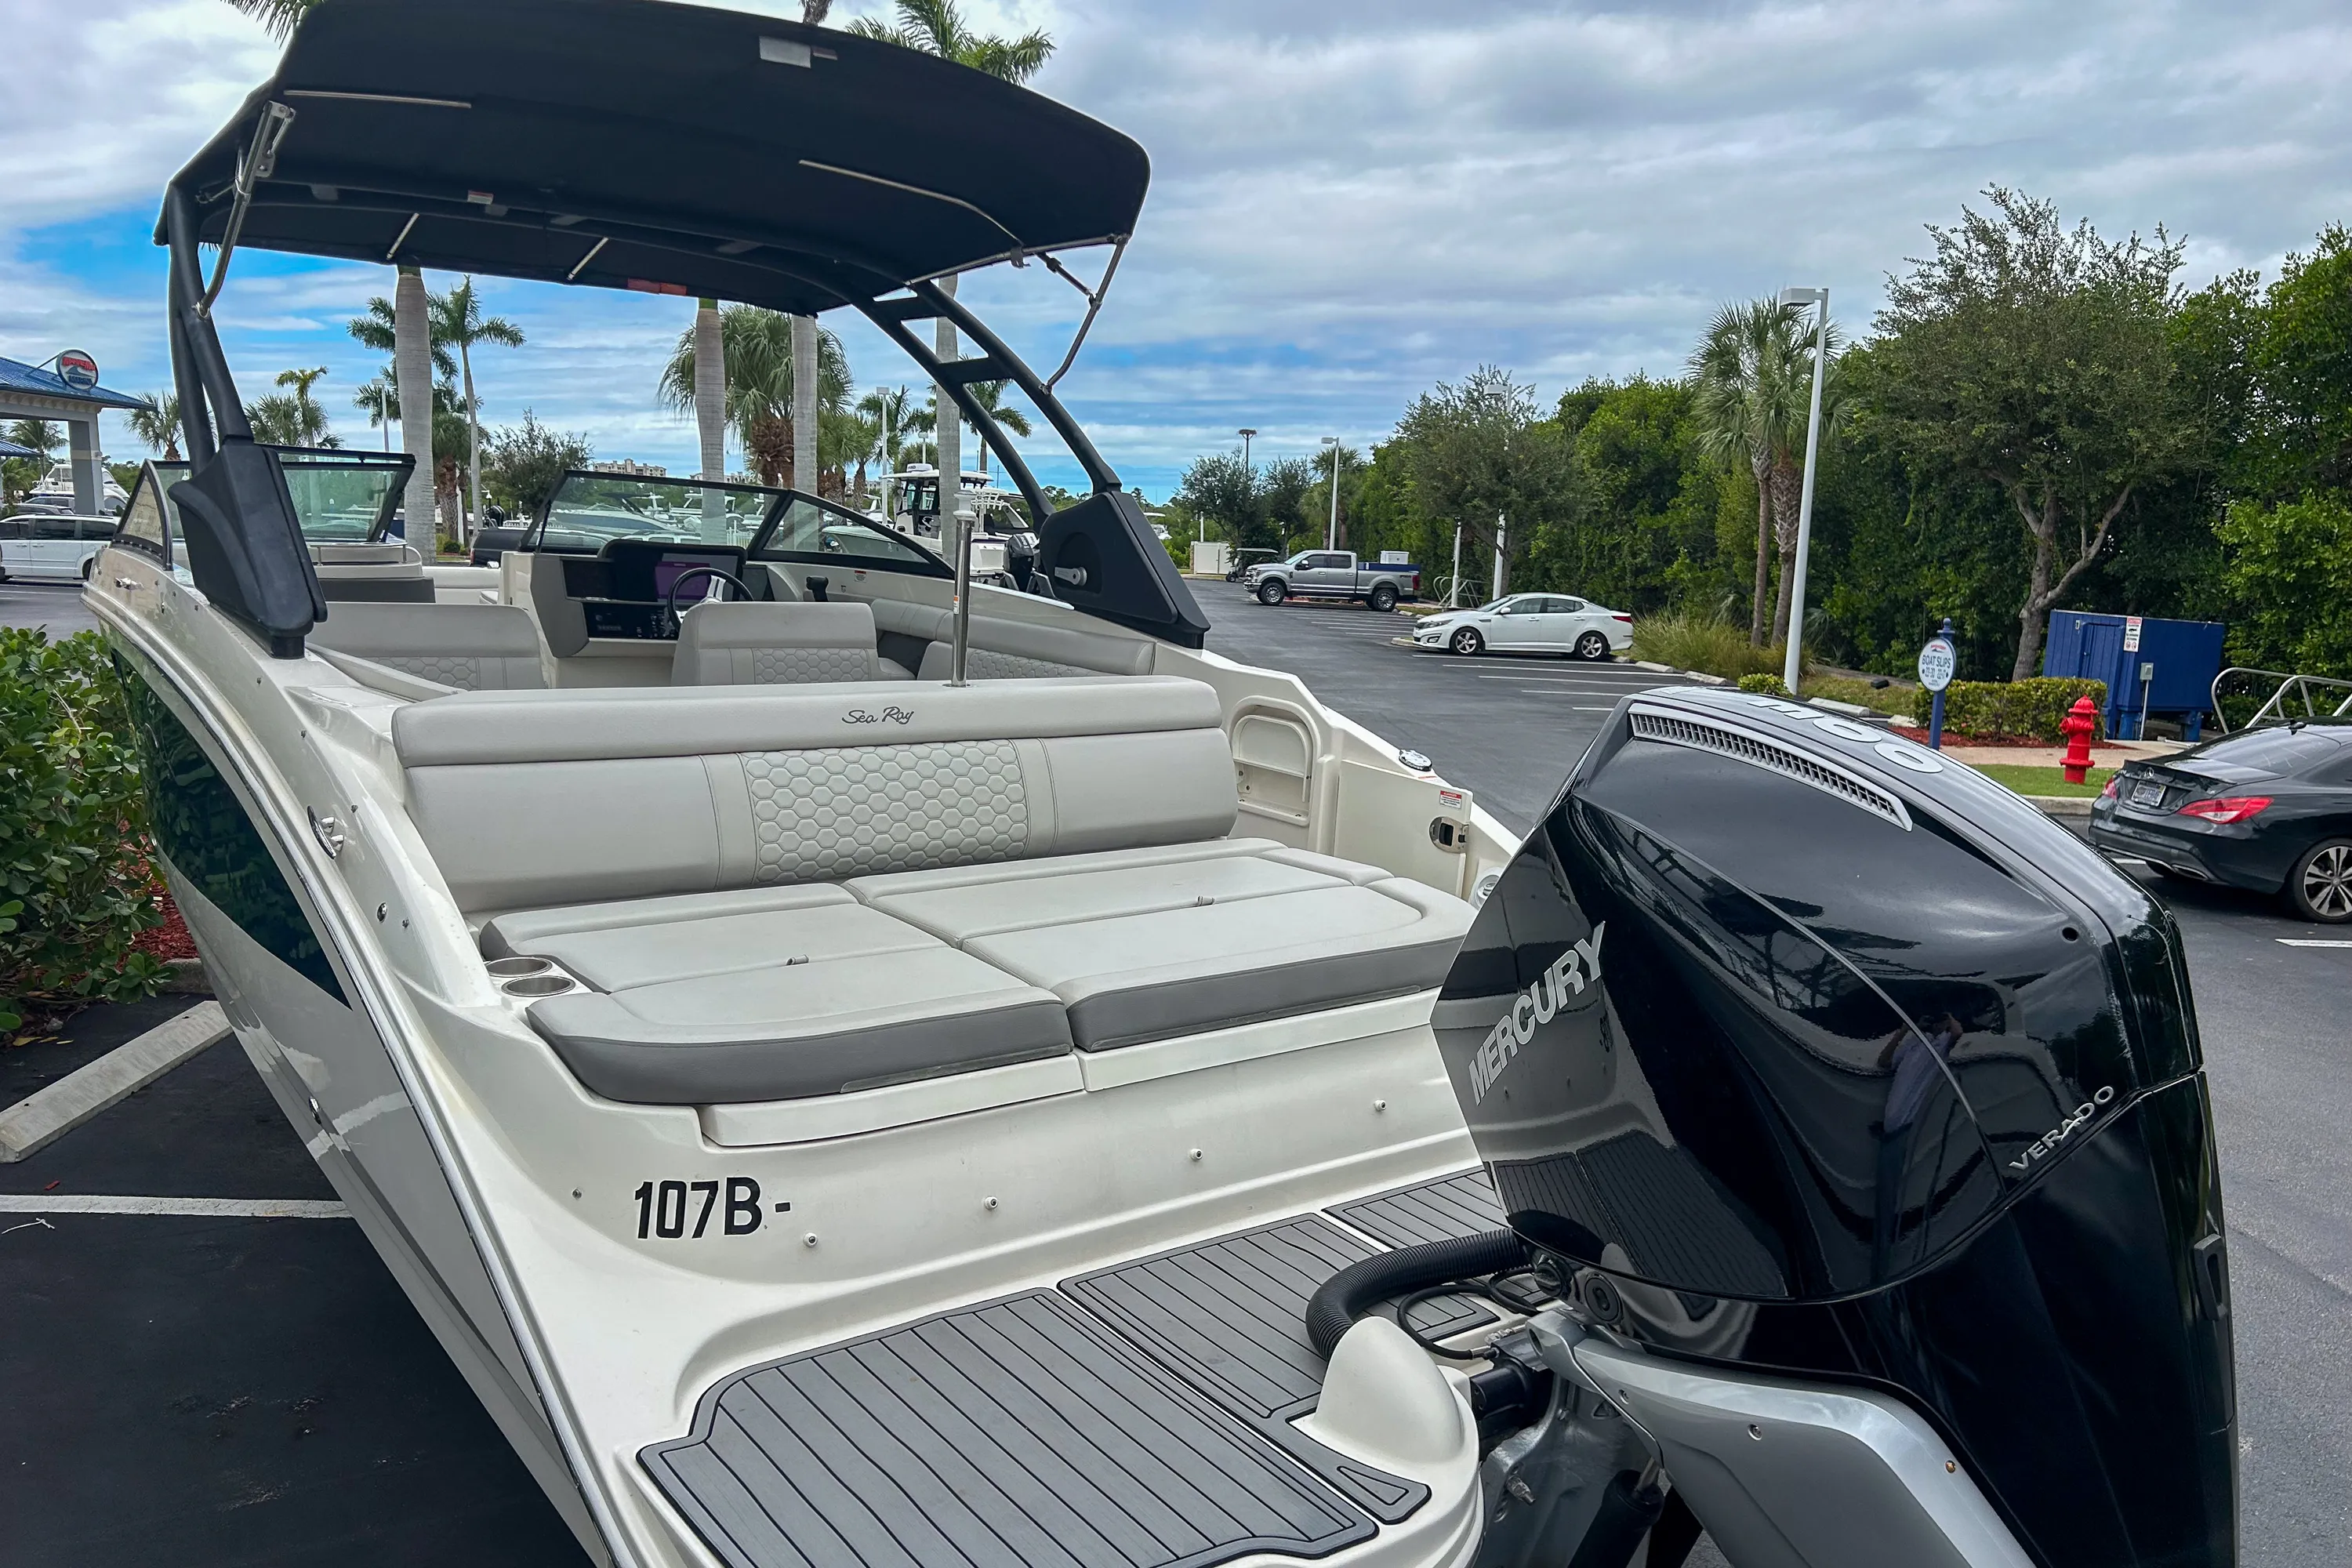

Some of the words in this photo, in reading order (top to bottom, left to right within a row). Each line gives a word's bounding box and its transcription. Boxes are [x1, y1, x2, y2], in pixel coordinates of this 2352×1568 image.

[1922, 654, 1936, 666] BOAT
[1936, 655, 1951, 669] SLIPS
[841, 710, 878, 724] Sea
[881, 706, 915, 725] Ray
[1468, 920, 1606, 1106] MERCURY
[2008, 1085, 2114, 1171] VERADO
